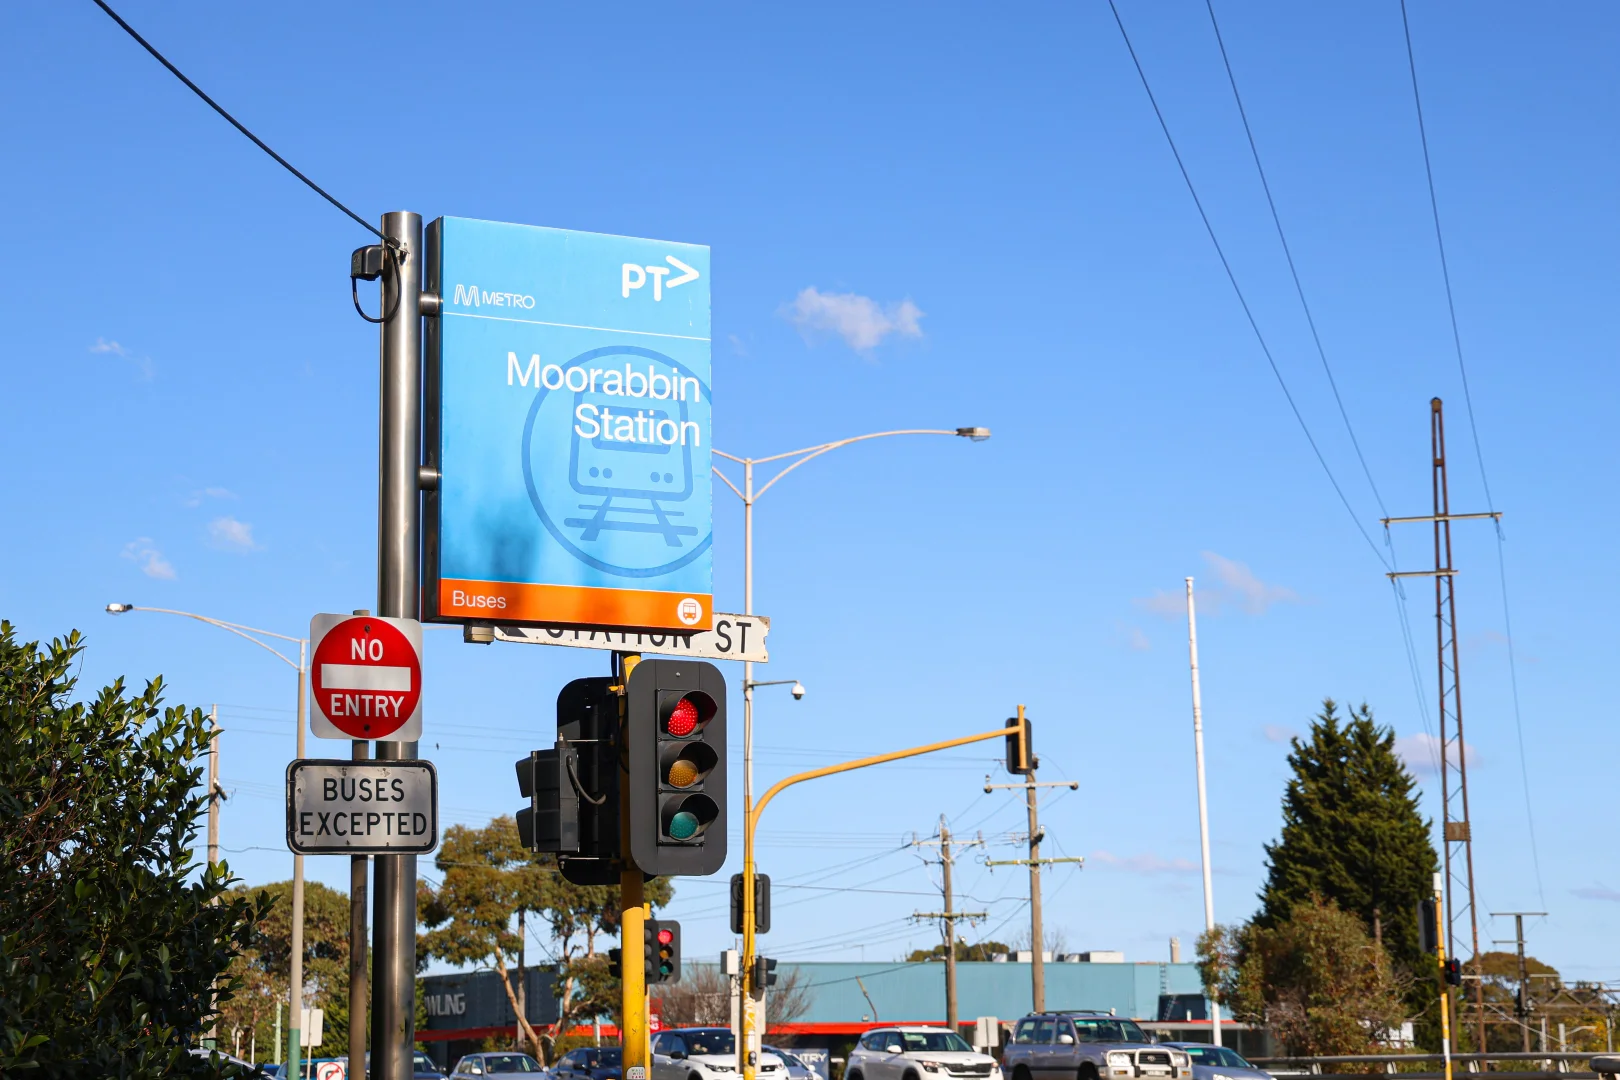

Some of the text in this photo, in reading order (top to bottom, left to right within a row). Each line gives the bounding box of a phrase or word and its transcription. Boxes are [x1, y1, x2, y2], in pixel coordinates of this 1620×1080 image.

[482, 291, 536, 309] METRO
[507, 351, 700, 403] Moorabbin
[574, 403, 700, 447] Station
[452, 590, 507, 609] Buses
[715, 620, 752, 654] ST
[351, 638, 384, 661] NO
[331, 694, 405, 718] ENTRY
[323, 778, 405, 802] BUSES
[300, 812, 427, 836] EXCEPTED
